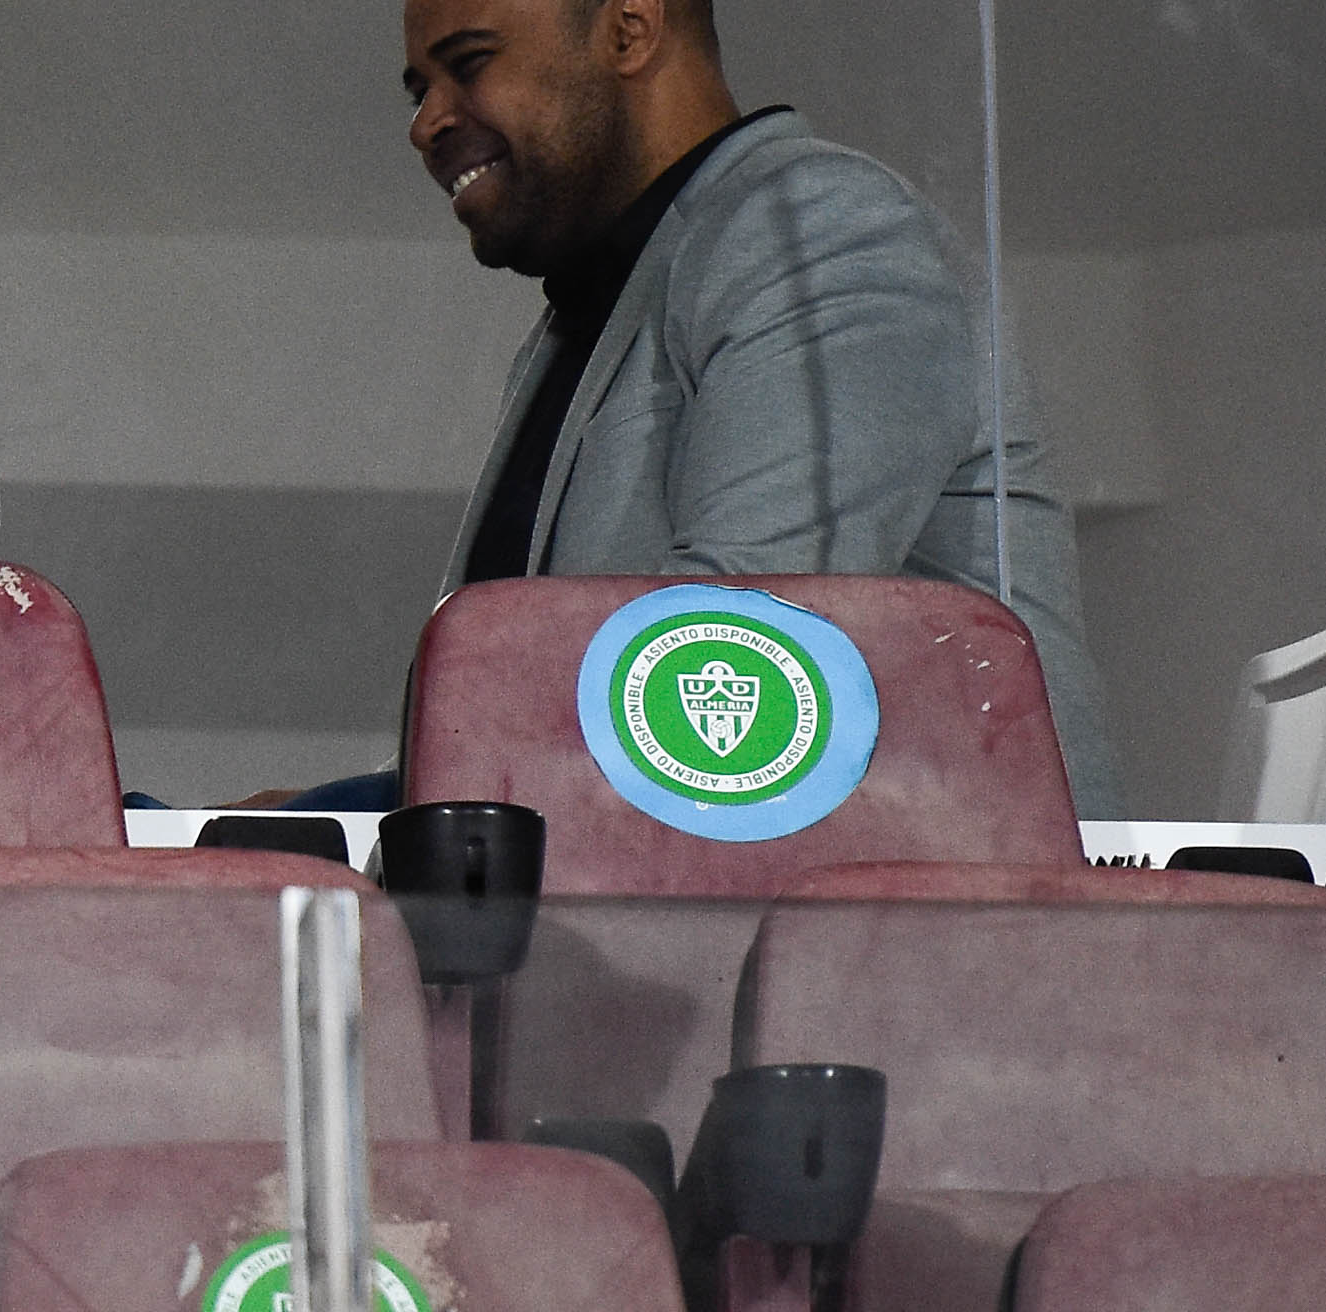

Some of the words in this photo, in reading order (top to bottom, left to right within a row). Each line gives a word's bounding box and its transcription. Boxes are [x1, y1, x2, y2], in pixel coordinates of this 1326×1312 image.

[643, 627, 700, 665] ASIENTO
[703, 626, 791, 668] DISPONIBLE
[687, 680, 705, 693] U
[732, 682, 750, 695] D
[689, 700, 750, 711] ALMERIA
[792, 675, 817, 736] ASIENTO
[628, 672, 660, 755] DISPONIBLE
[657, 756, 719, 789] ASIENTO
[735, 736, 809, 789] DISPONIBLE
